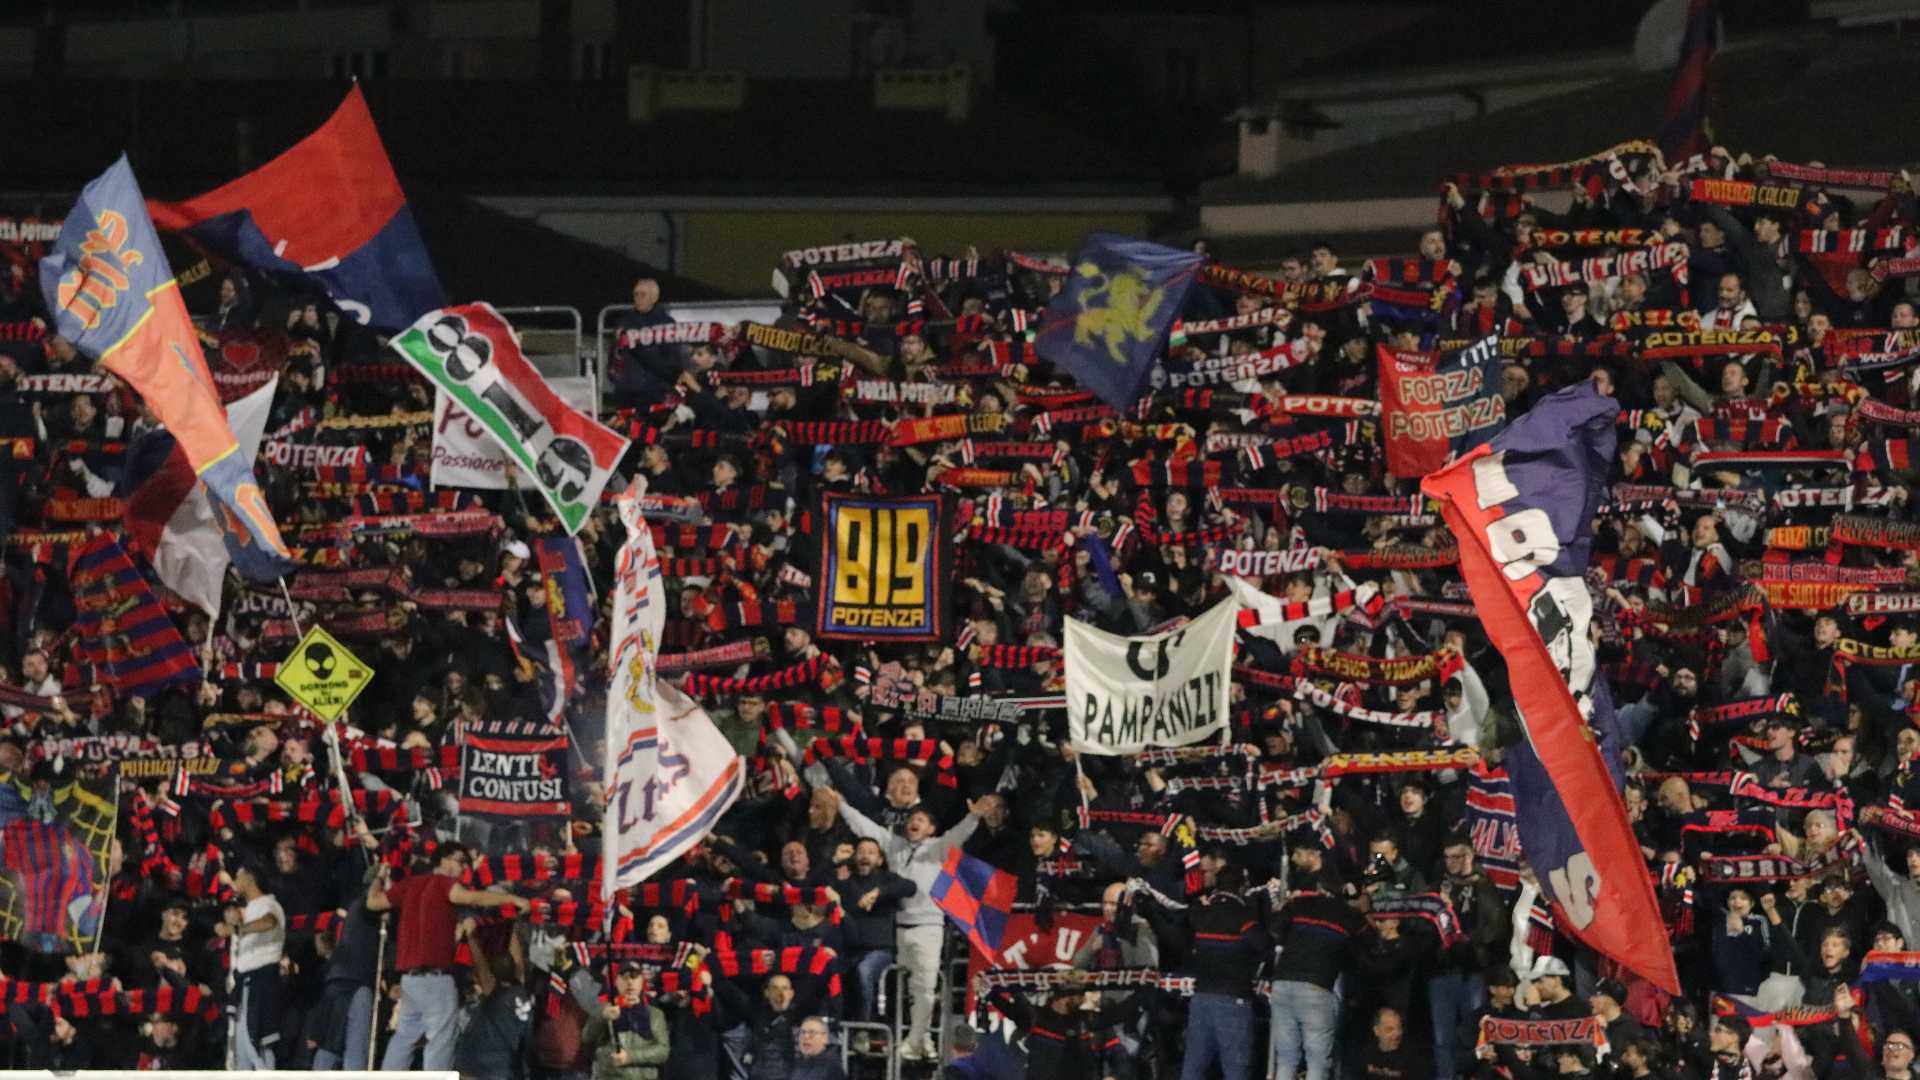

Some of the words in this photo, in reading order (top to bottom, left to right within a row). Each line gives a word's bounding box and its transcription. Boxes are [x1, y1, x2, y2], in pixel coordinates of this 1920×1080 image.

[788, 239, 903, 267] POTENZA
[627, 322, 712, 349] POTENZA
[1646, 331, 1773, 349] POTENZA
[1169, 354, 1290, 388] POTENZA
[1399, 366, 1484, 405] FORZA
[1389, 394, 1506, 441] POTENZA
[265, 441, 359, 468] POTENZA
[834, 506, 930, 605] 819
[1221, 547, 1321, 577] POTENZA
[831, 608, 925, 627] POTENZA
[470, 750, 541, 777] LENTI
[469, 776, 563, 801] CONFUSI
[1485, 1018, 1599, 1044] POTENZA
